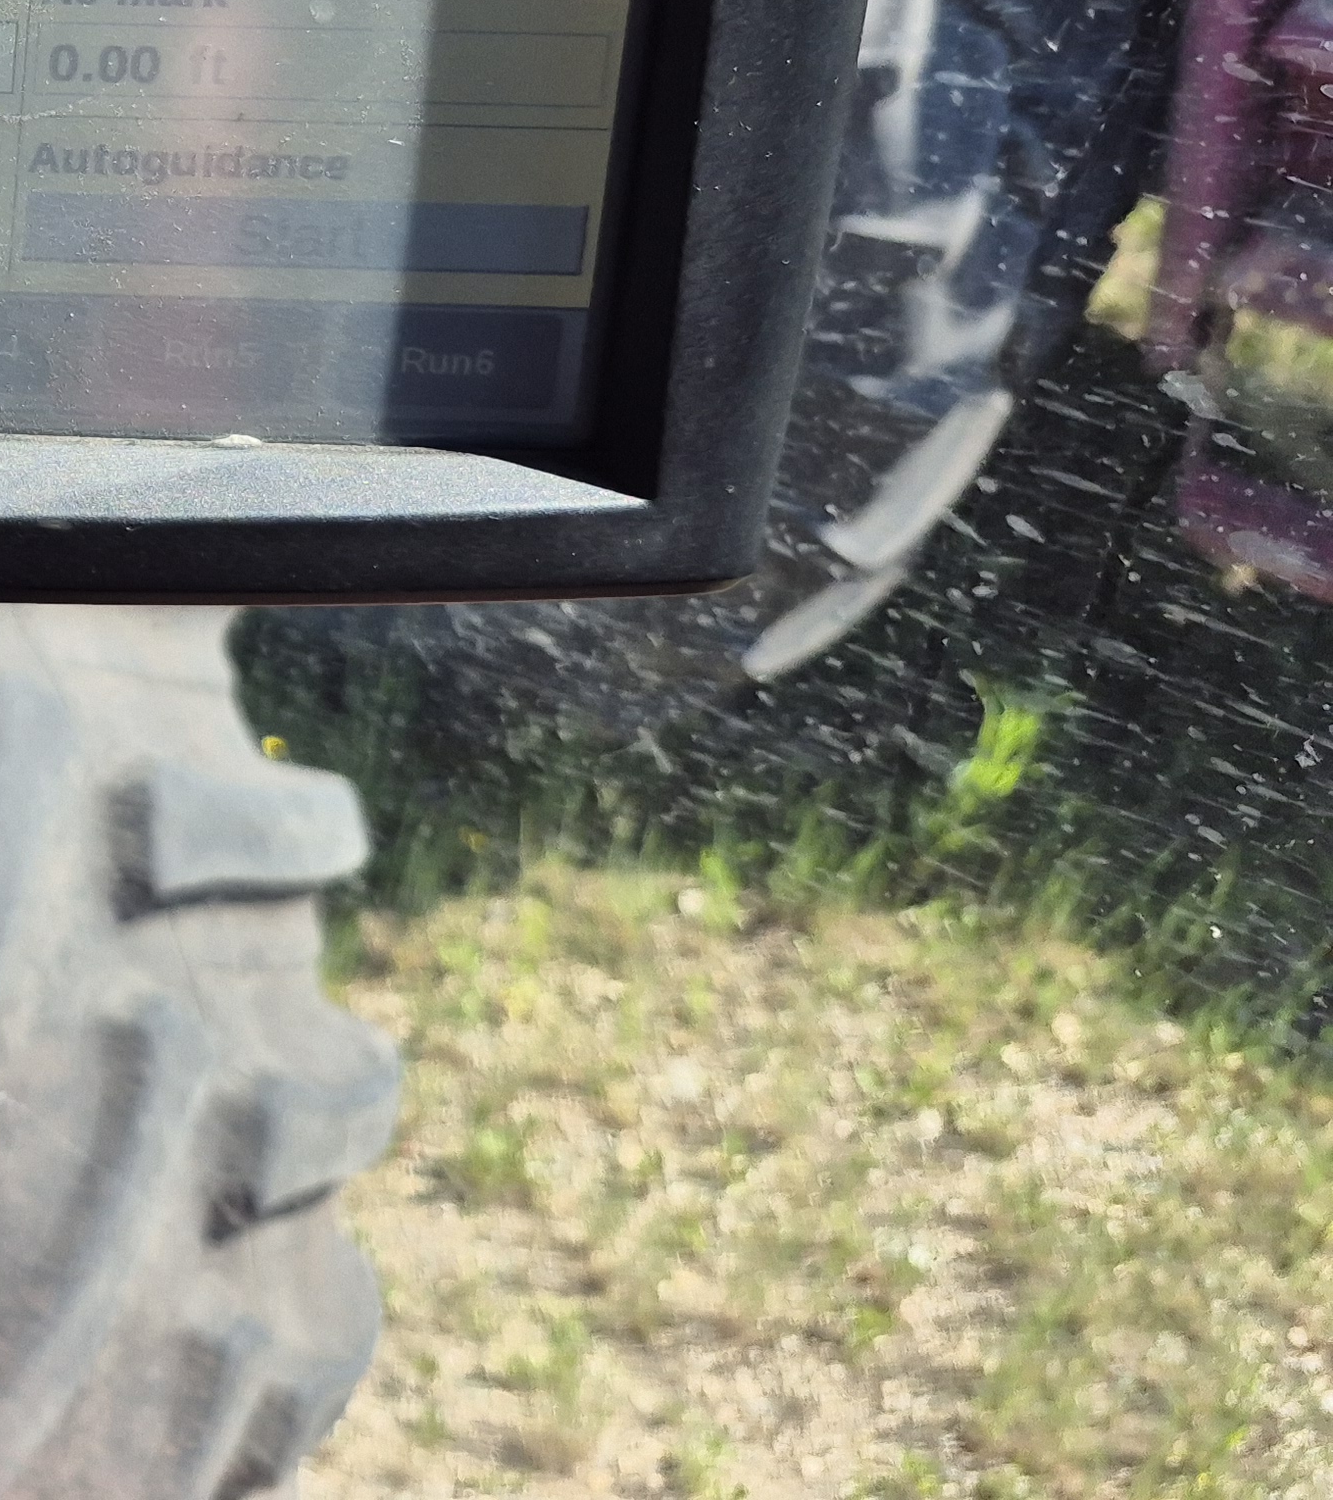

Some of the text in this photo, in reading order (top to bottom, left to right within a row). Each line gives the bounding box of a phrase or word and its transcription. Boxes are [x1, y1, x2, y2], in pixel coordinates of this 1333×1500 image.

[49, 44, 229, 86] 0.00 ft
[28, 143, 350, 185] Autoguidance
[401, 346, 496, 376] Run6
